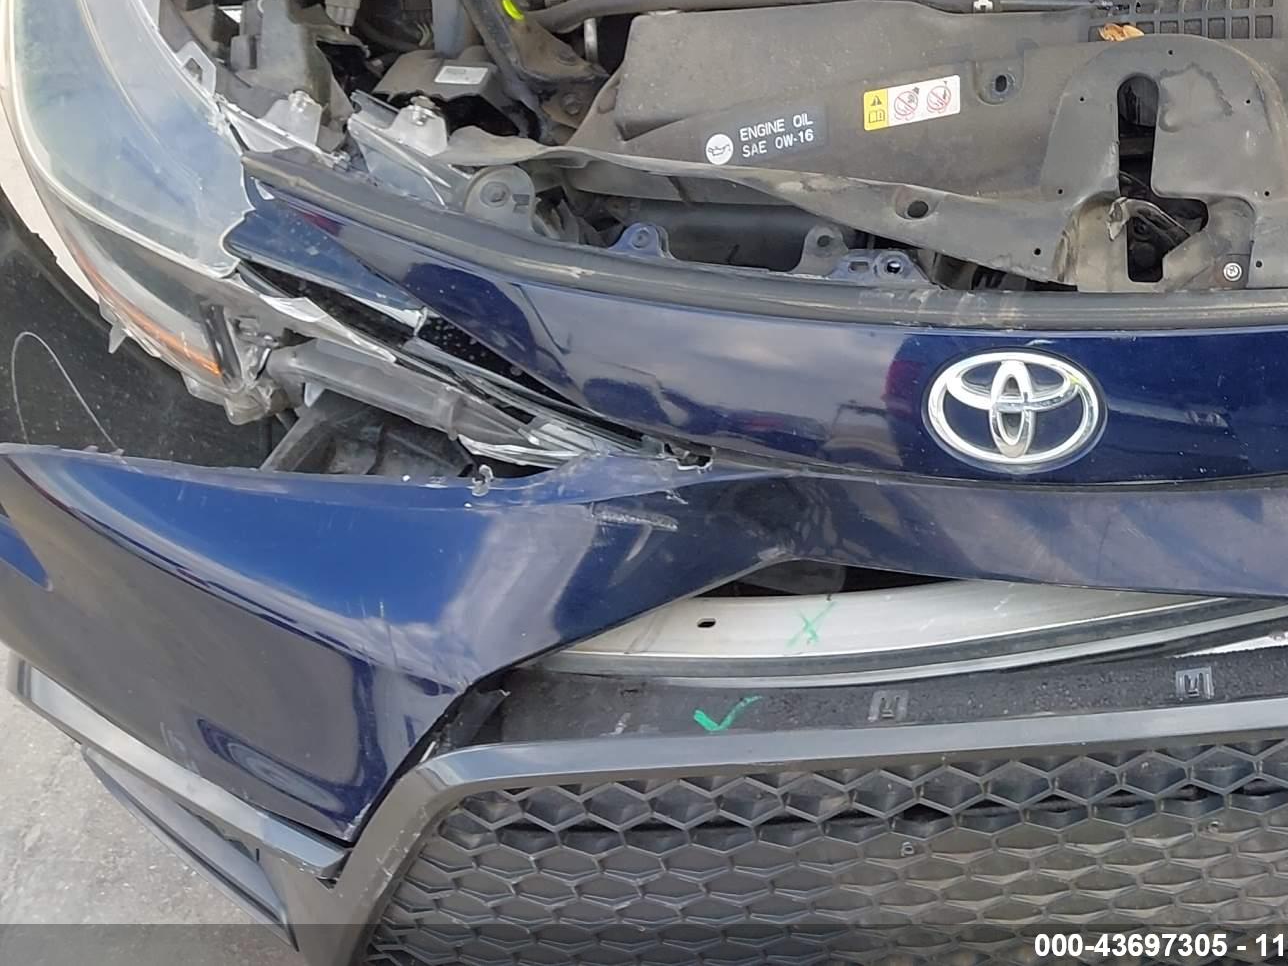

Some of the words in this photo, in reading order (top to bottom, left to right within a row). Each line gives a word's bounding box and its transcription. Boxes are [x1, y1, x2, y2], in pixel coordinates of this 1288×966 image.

[740, 118, 785, 141] ENGINE
[793, 113, 814, 128] OIL
[742, 140, 767, 158] SAE
[775, 128, 814, 149] 0W-16
